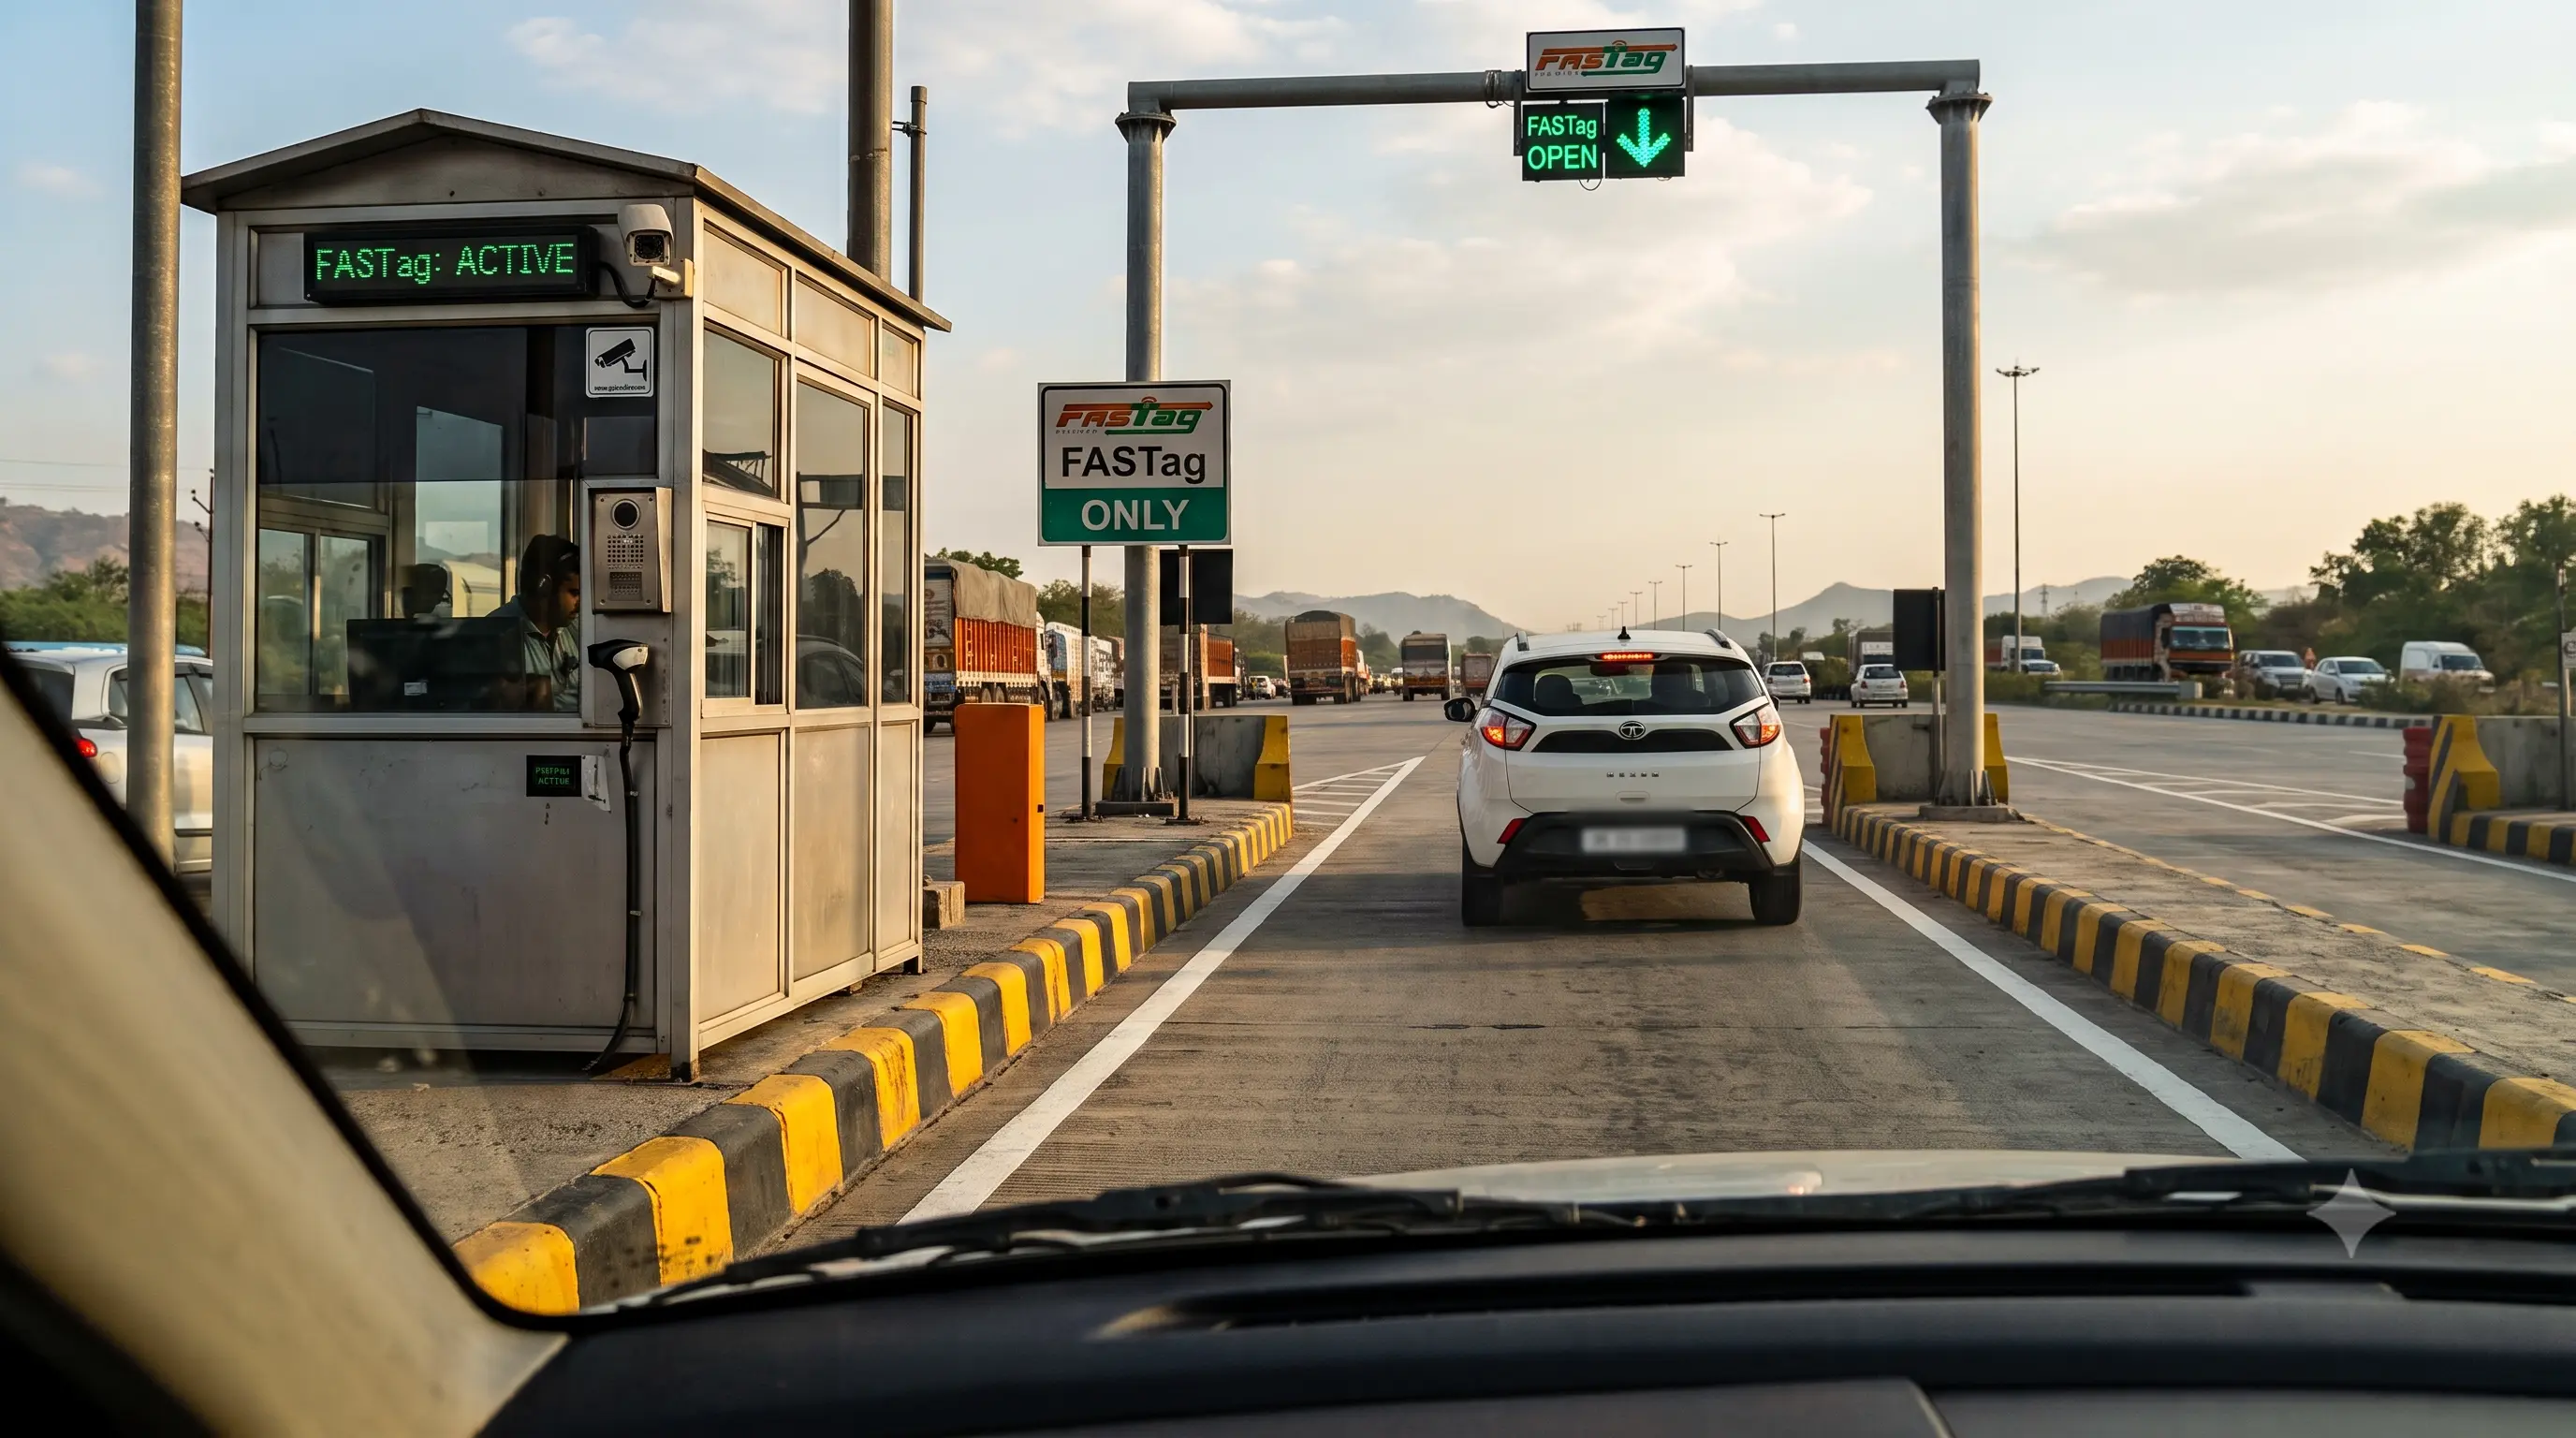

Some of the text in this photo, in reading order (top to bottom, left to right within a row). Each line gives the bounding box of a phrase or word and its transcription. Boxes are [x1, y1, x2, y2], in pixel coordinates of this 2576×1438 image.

[1527, 114, 1597, 139] FASTag
[1527, 144, 1597, 169] OPEN
[316, 243, 574, 285] FASTag: ACTIVE
[1061, 446, 1206, 485] FASTag
[1081, 499, 1190, 531] ONLY
